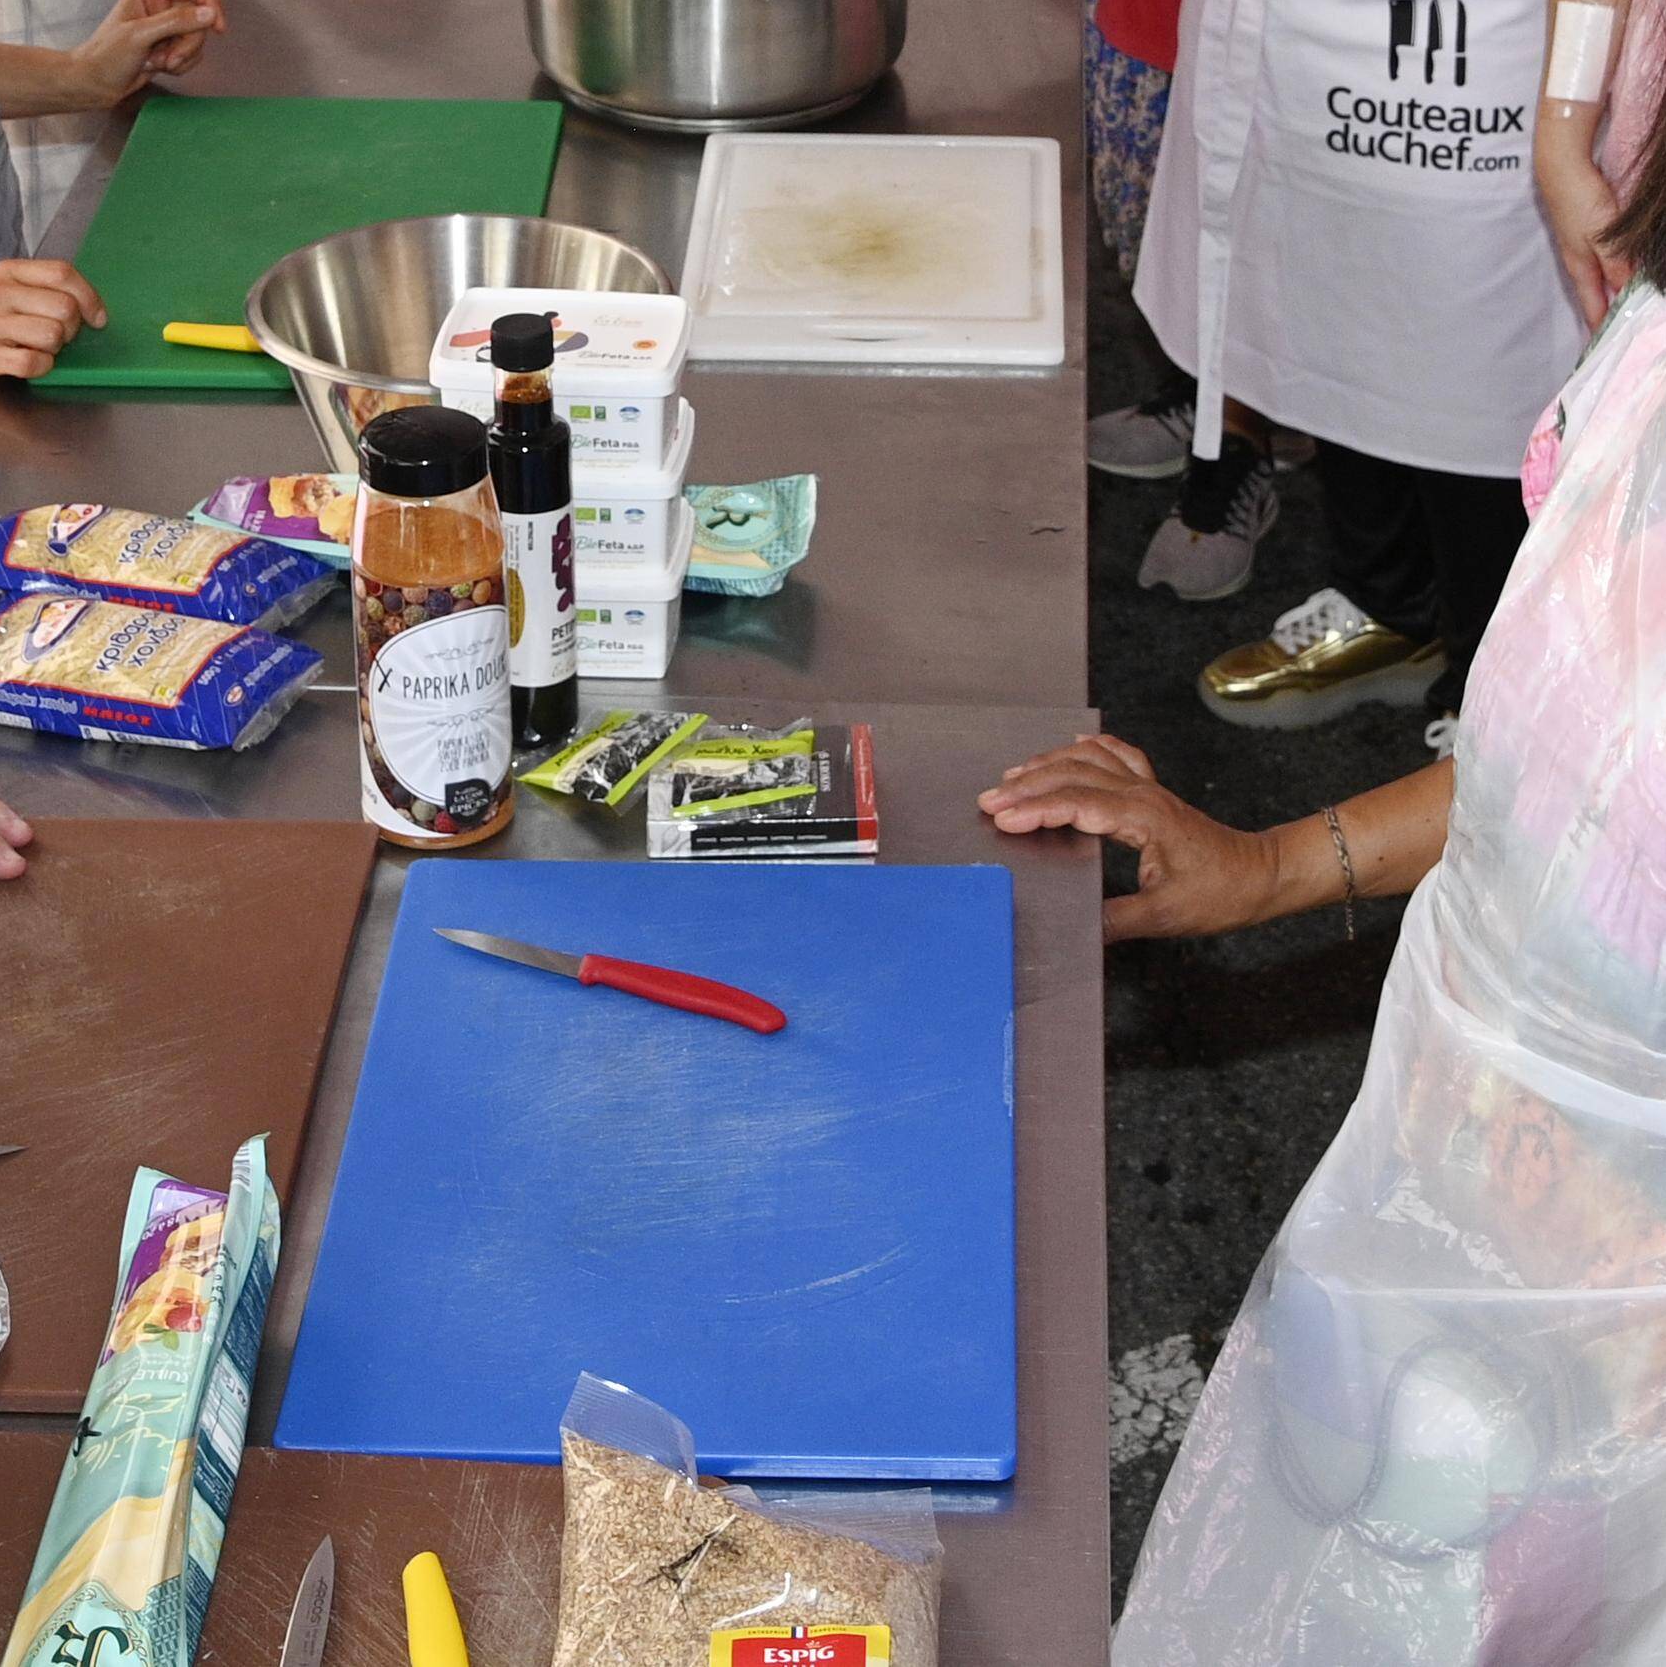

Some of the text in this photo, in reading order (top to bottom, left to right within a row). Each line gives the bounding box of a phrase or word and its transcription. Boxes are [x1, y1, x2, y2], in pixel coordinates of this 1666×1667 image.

[1327, 86, 1524, 134] Couteaux
[1326, 122, 1520, 172] duChef.com
[402, 672, 471, 700] PAPRIKA
[763, 1645, 835, 1664] ESPIG
